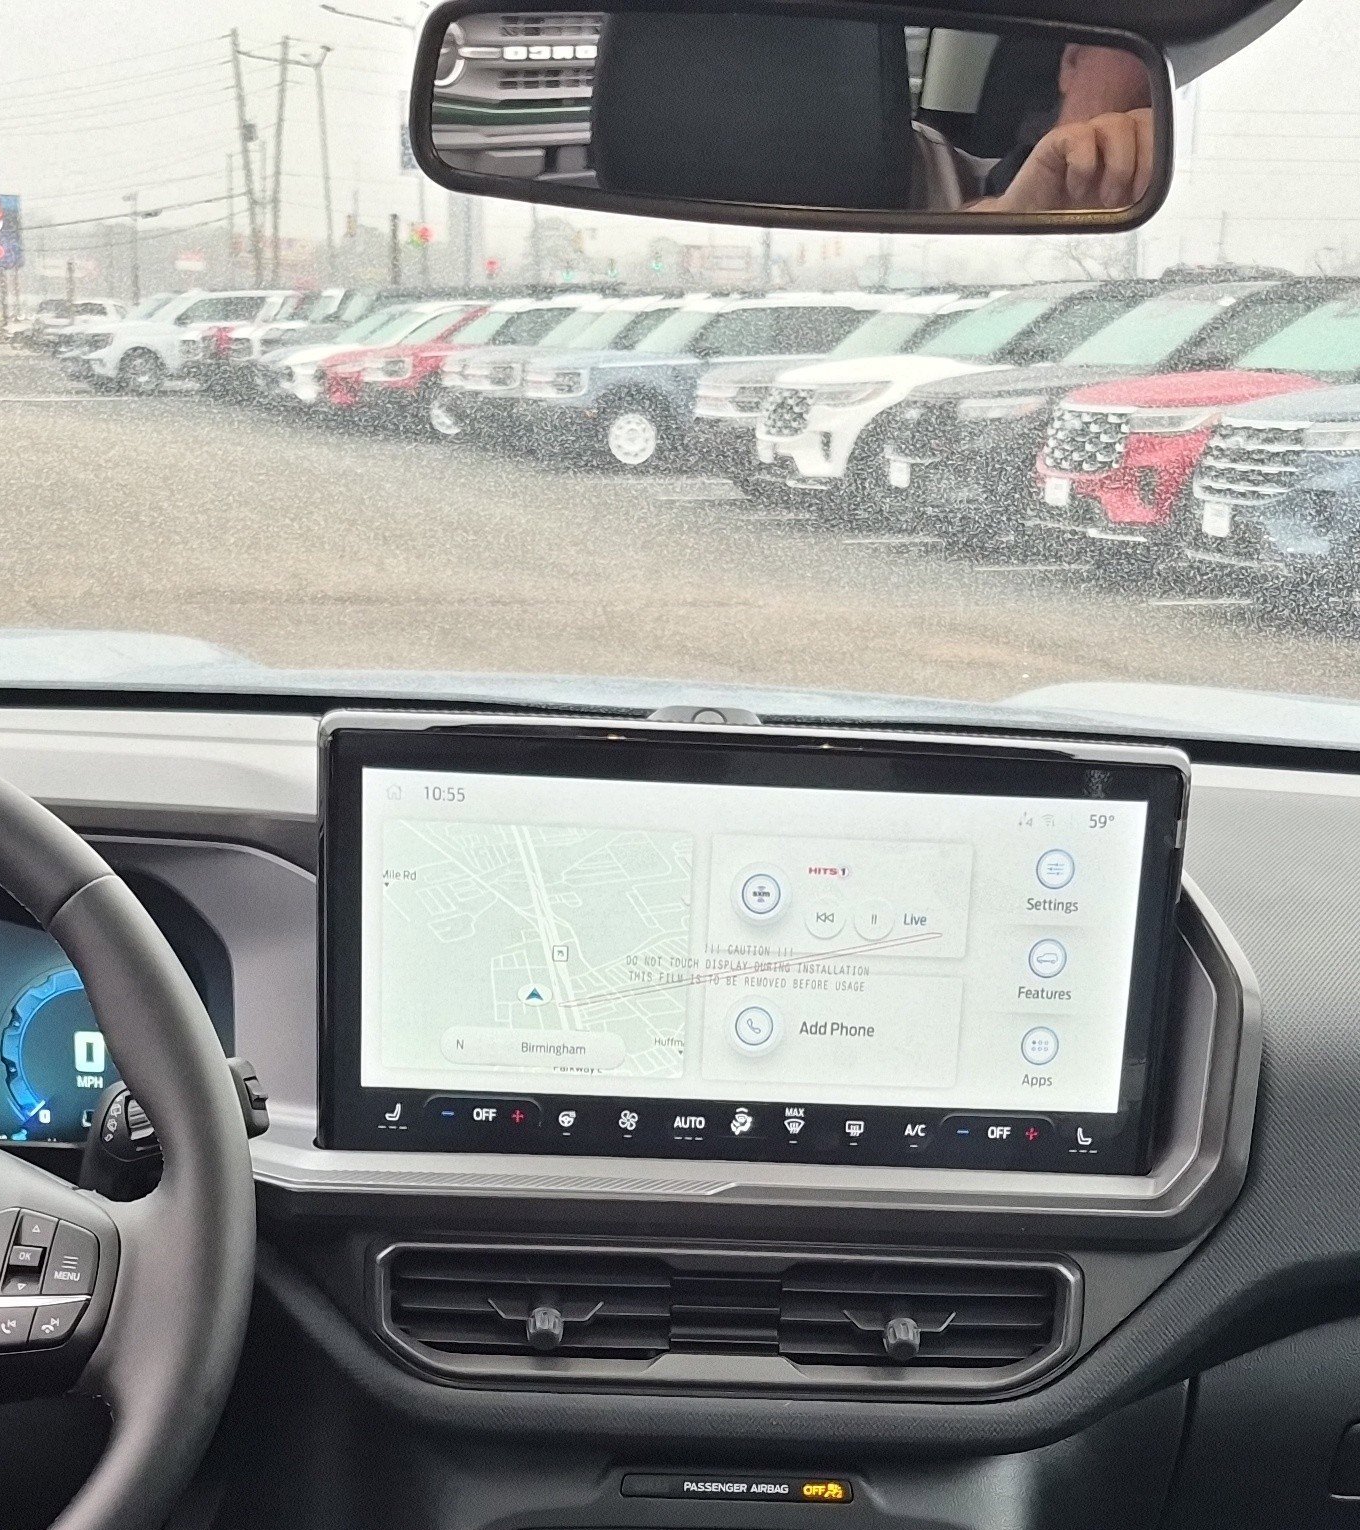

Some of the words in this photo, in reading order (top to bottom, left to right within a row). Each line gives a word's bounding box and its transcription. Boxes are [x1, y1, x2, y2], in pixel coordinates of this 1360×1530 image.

[424, 786, 465, 802] 10:55
[1089, 814, 1115, 829] 59°
[403, 869, 417, 881] Rd
[808, 867, 838, 876] HITS
[1026, 897, 1079, 914] Settings
[903, 913, 927, 926] Live
[728, 944, 770, 956] CAUTION
[626, 955, 638, 966] DO
[645, 956, 661, 967] NOT
[670, 957, 699, 969] TOUCH
[705, 958, 748, 970] DISPLAY
[754, 961, 791, 973] DURING
[797, 963, 870, 976] INSTALLATION
[628, 971, 653, 983] THIS
[659, 972, 683, 984] FILM
[690, 974, 701, 985] IS
[708, 974, 720, 985] TO
[726, 976, 737, 986] BE
[744, 976, 787, 988] REMOVED
[793, 978, 828, 990] BEFORE
[835, 980, 865, 992] USAGE
[1017, 985, 1072, 1000] Features
[799, 1021, 827, 1035] Add
[830, 1022, 875, 1037] Phone
[456, 1039, 464, 1050] N
[521, 1041, 586, 1057] Birmingham
[654, 1037, 685, 1048] Huffm
[74, 1031, 105, 1073] 0
[76, 1075, 104, 1089] MPH
[1021, 1073, 1053, 1088] Apps
[39, 1109, 51, 1124] 0
[473, 1108, 497, 1121] OFF
[673, 1116, 705, 1129] AUTO
[785, 1107, 805, 1118] MAX
[905, 1123, 926, 1137] A/C
[987, 1126, 1011, 1140] OFF
[18, 1251, 32, 1261] OK
[53, 1270, 81, 1282] MENU
[683, 1481, 747, 1493] PASSENGER
[750, 1483, 789, 1494] AIRBAG
[802, 1484, 826, 1496] OFF
